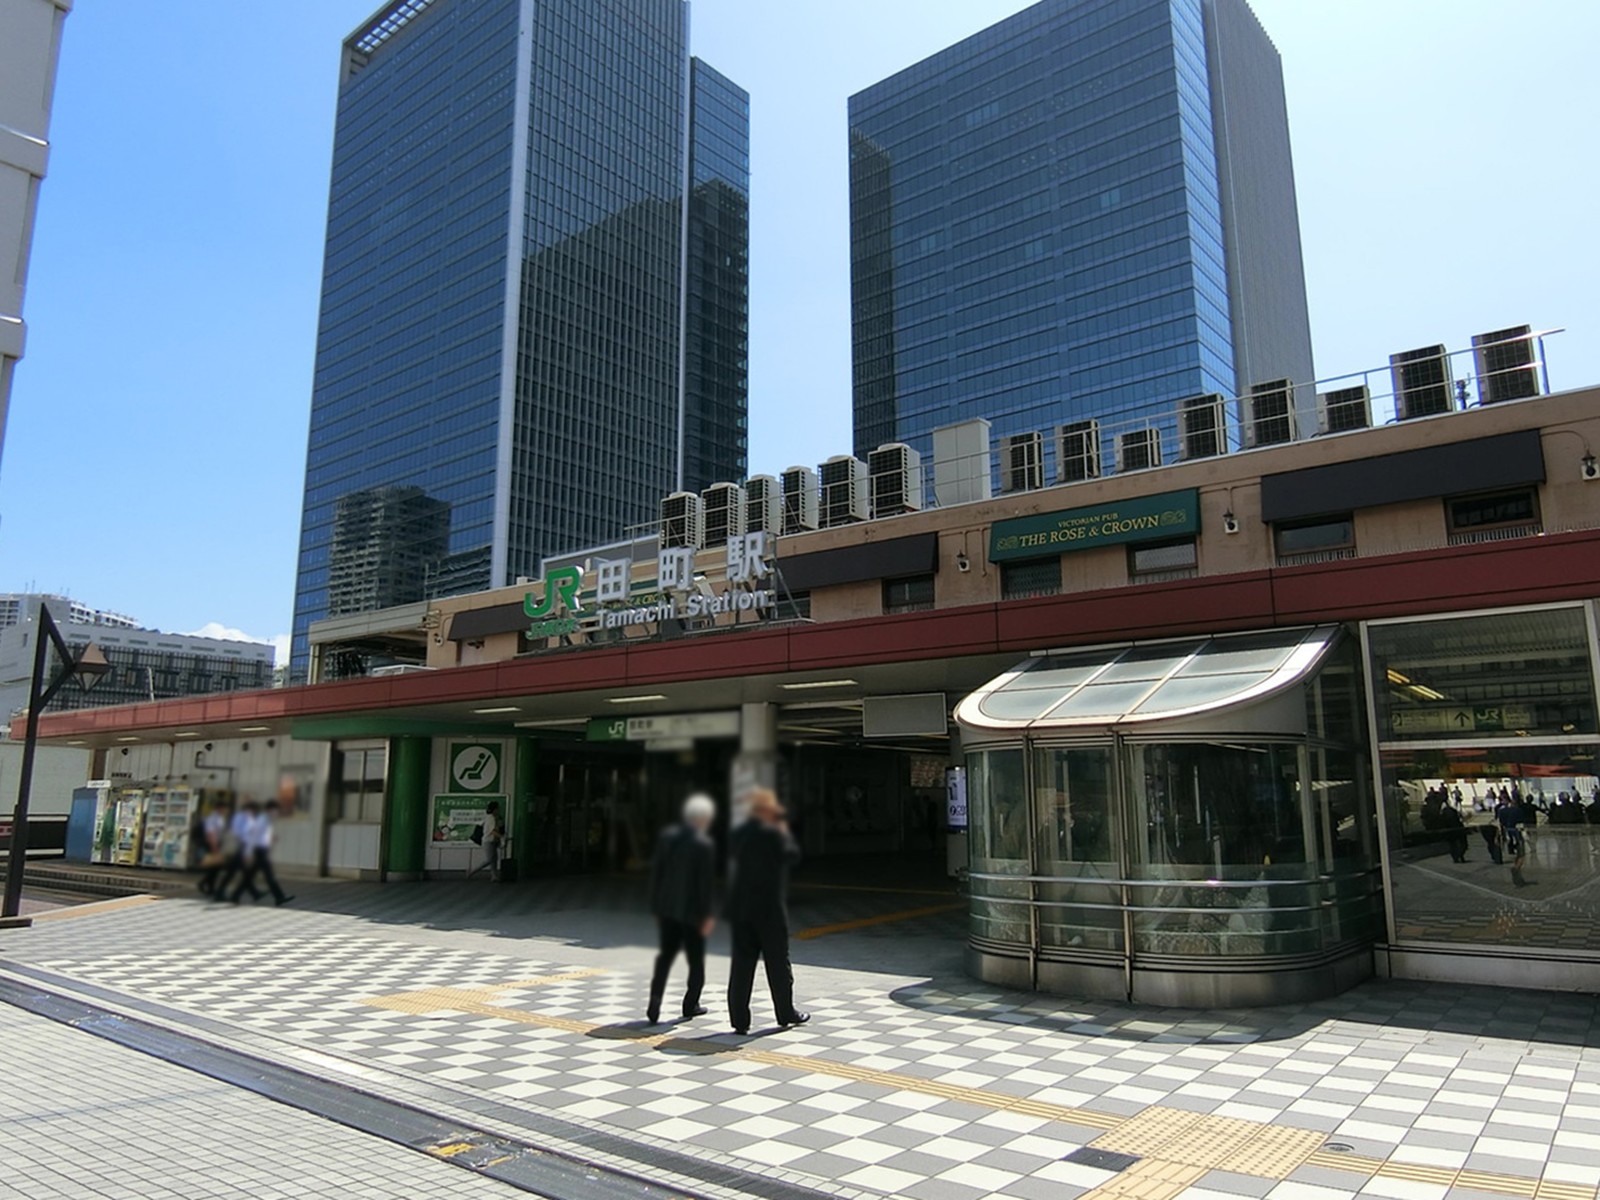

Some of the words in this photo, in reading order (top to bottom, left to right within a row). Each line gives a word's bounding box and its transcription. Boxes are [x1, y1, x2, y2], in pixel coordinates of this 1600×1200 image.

[1019, 533, 1047, 547] THE
[1050, 527, 1086, 543] ROSE
[1088, 526, 1100, 537] &
[1101, 515, 1160, 536] CROWN
[1058, 514, 1100, 528] VICTORIAN
[1102, 512, 1119, 521] PUB
[597, 531, 768, 604] 田町駅
[523, 565, 583, 618] JR
[597, 597, 676, 629] Tamachi
[687, 589, 768, 617] Station
[608, 721, 625, 735] JR
[1476, 708, 1499, 720] JR
